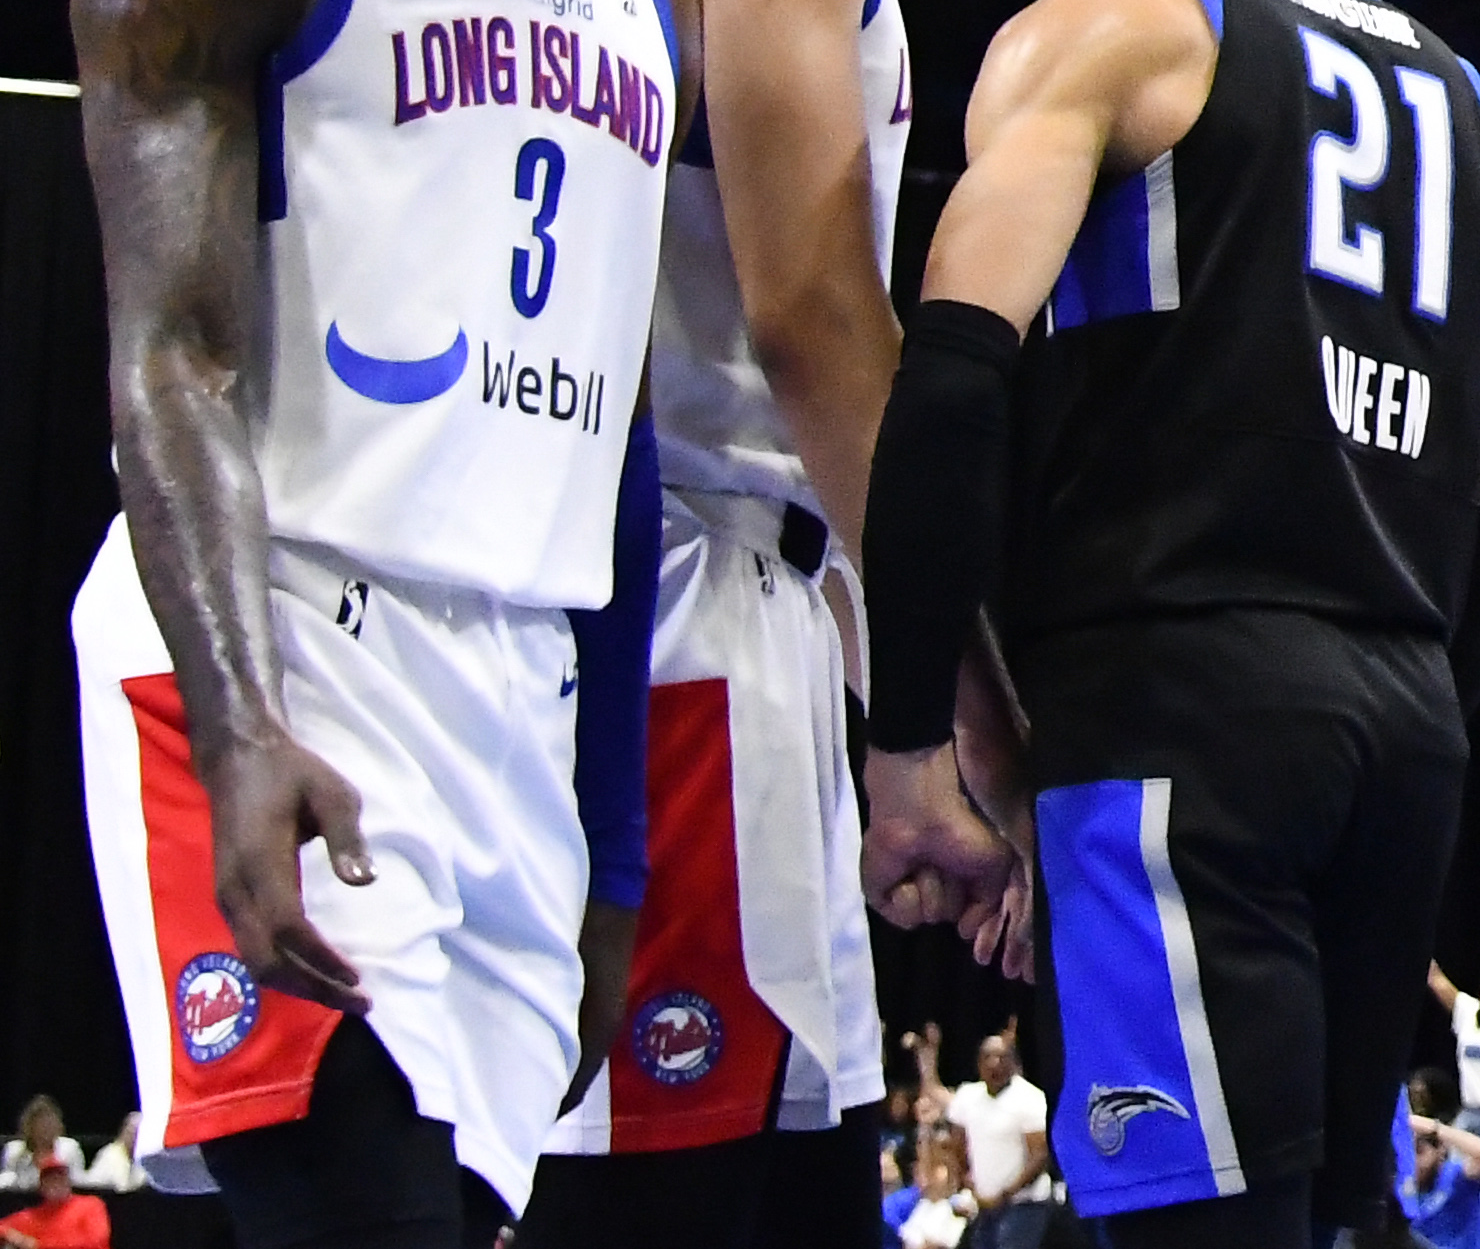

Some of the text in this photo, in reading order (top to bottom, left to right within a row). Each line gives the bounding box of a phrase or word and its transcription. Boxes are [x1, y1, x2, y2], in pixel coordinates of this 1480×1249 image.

[391, 16, 664, 168] LONG ISLAND
[1298, 24, 1456, 325] 21
[510, 137, 566, 319] 3
[482, 340, 604, 436] Webll
